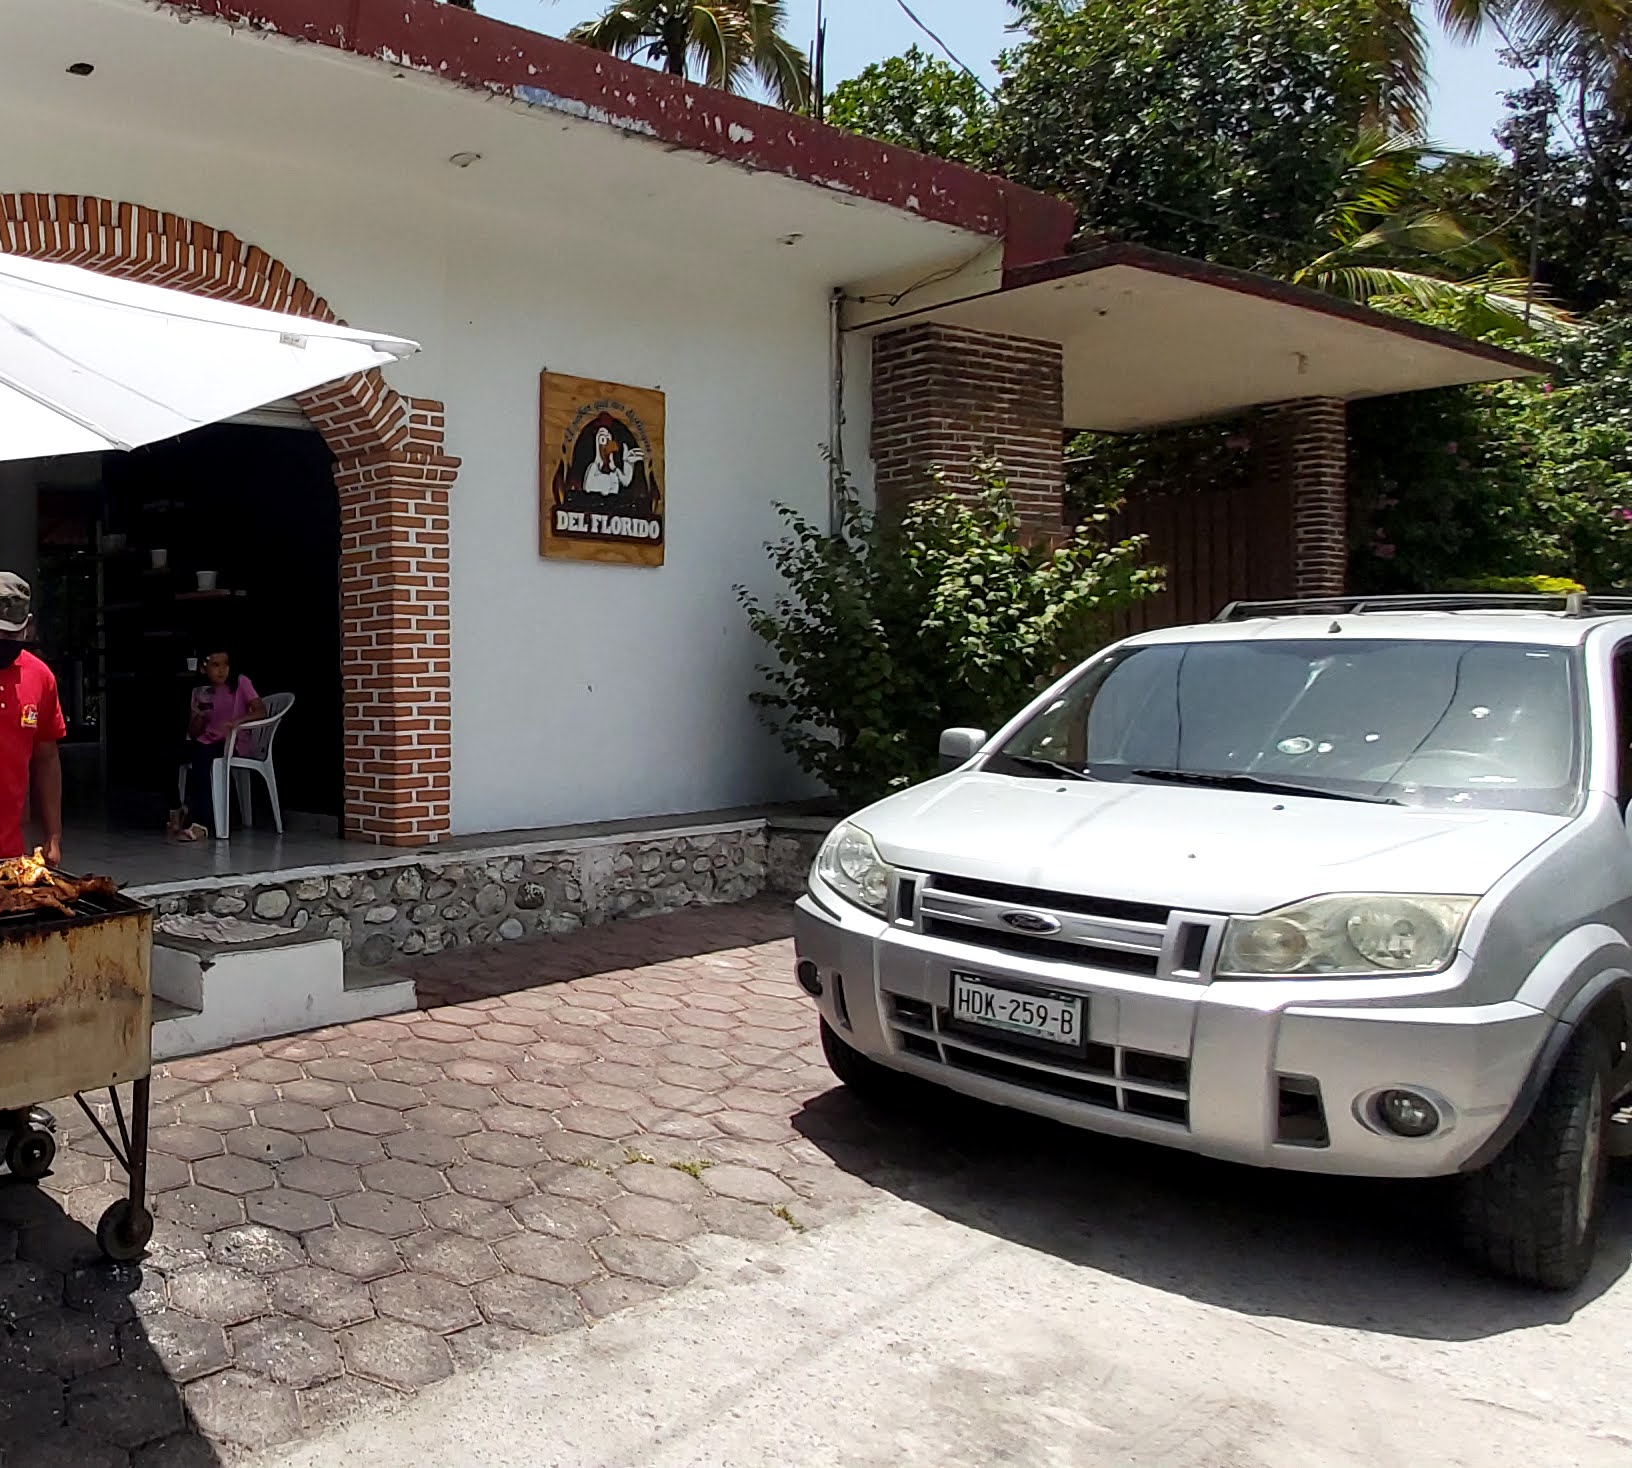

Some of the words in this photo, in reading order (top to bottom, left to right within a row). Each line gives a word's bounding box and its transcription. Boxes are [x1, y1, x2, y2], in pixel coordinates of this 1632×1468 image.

[556, 510, 588, 532] DEL
[590, 514, 660, 539] FLORIDO
[958, 987, 1074, 1035] HDK-259-B
